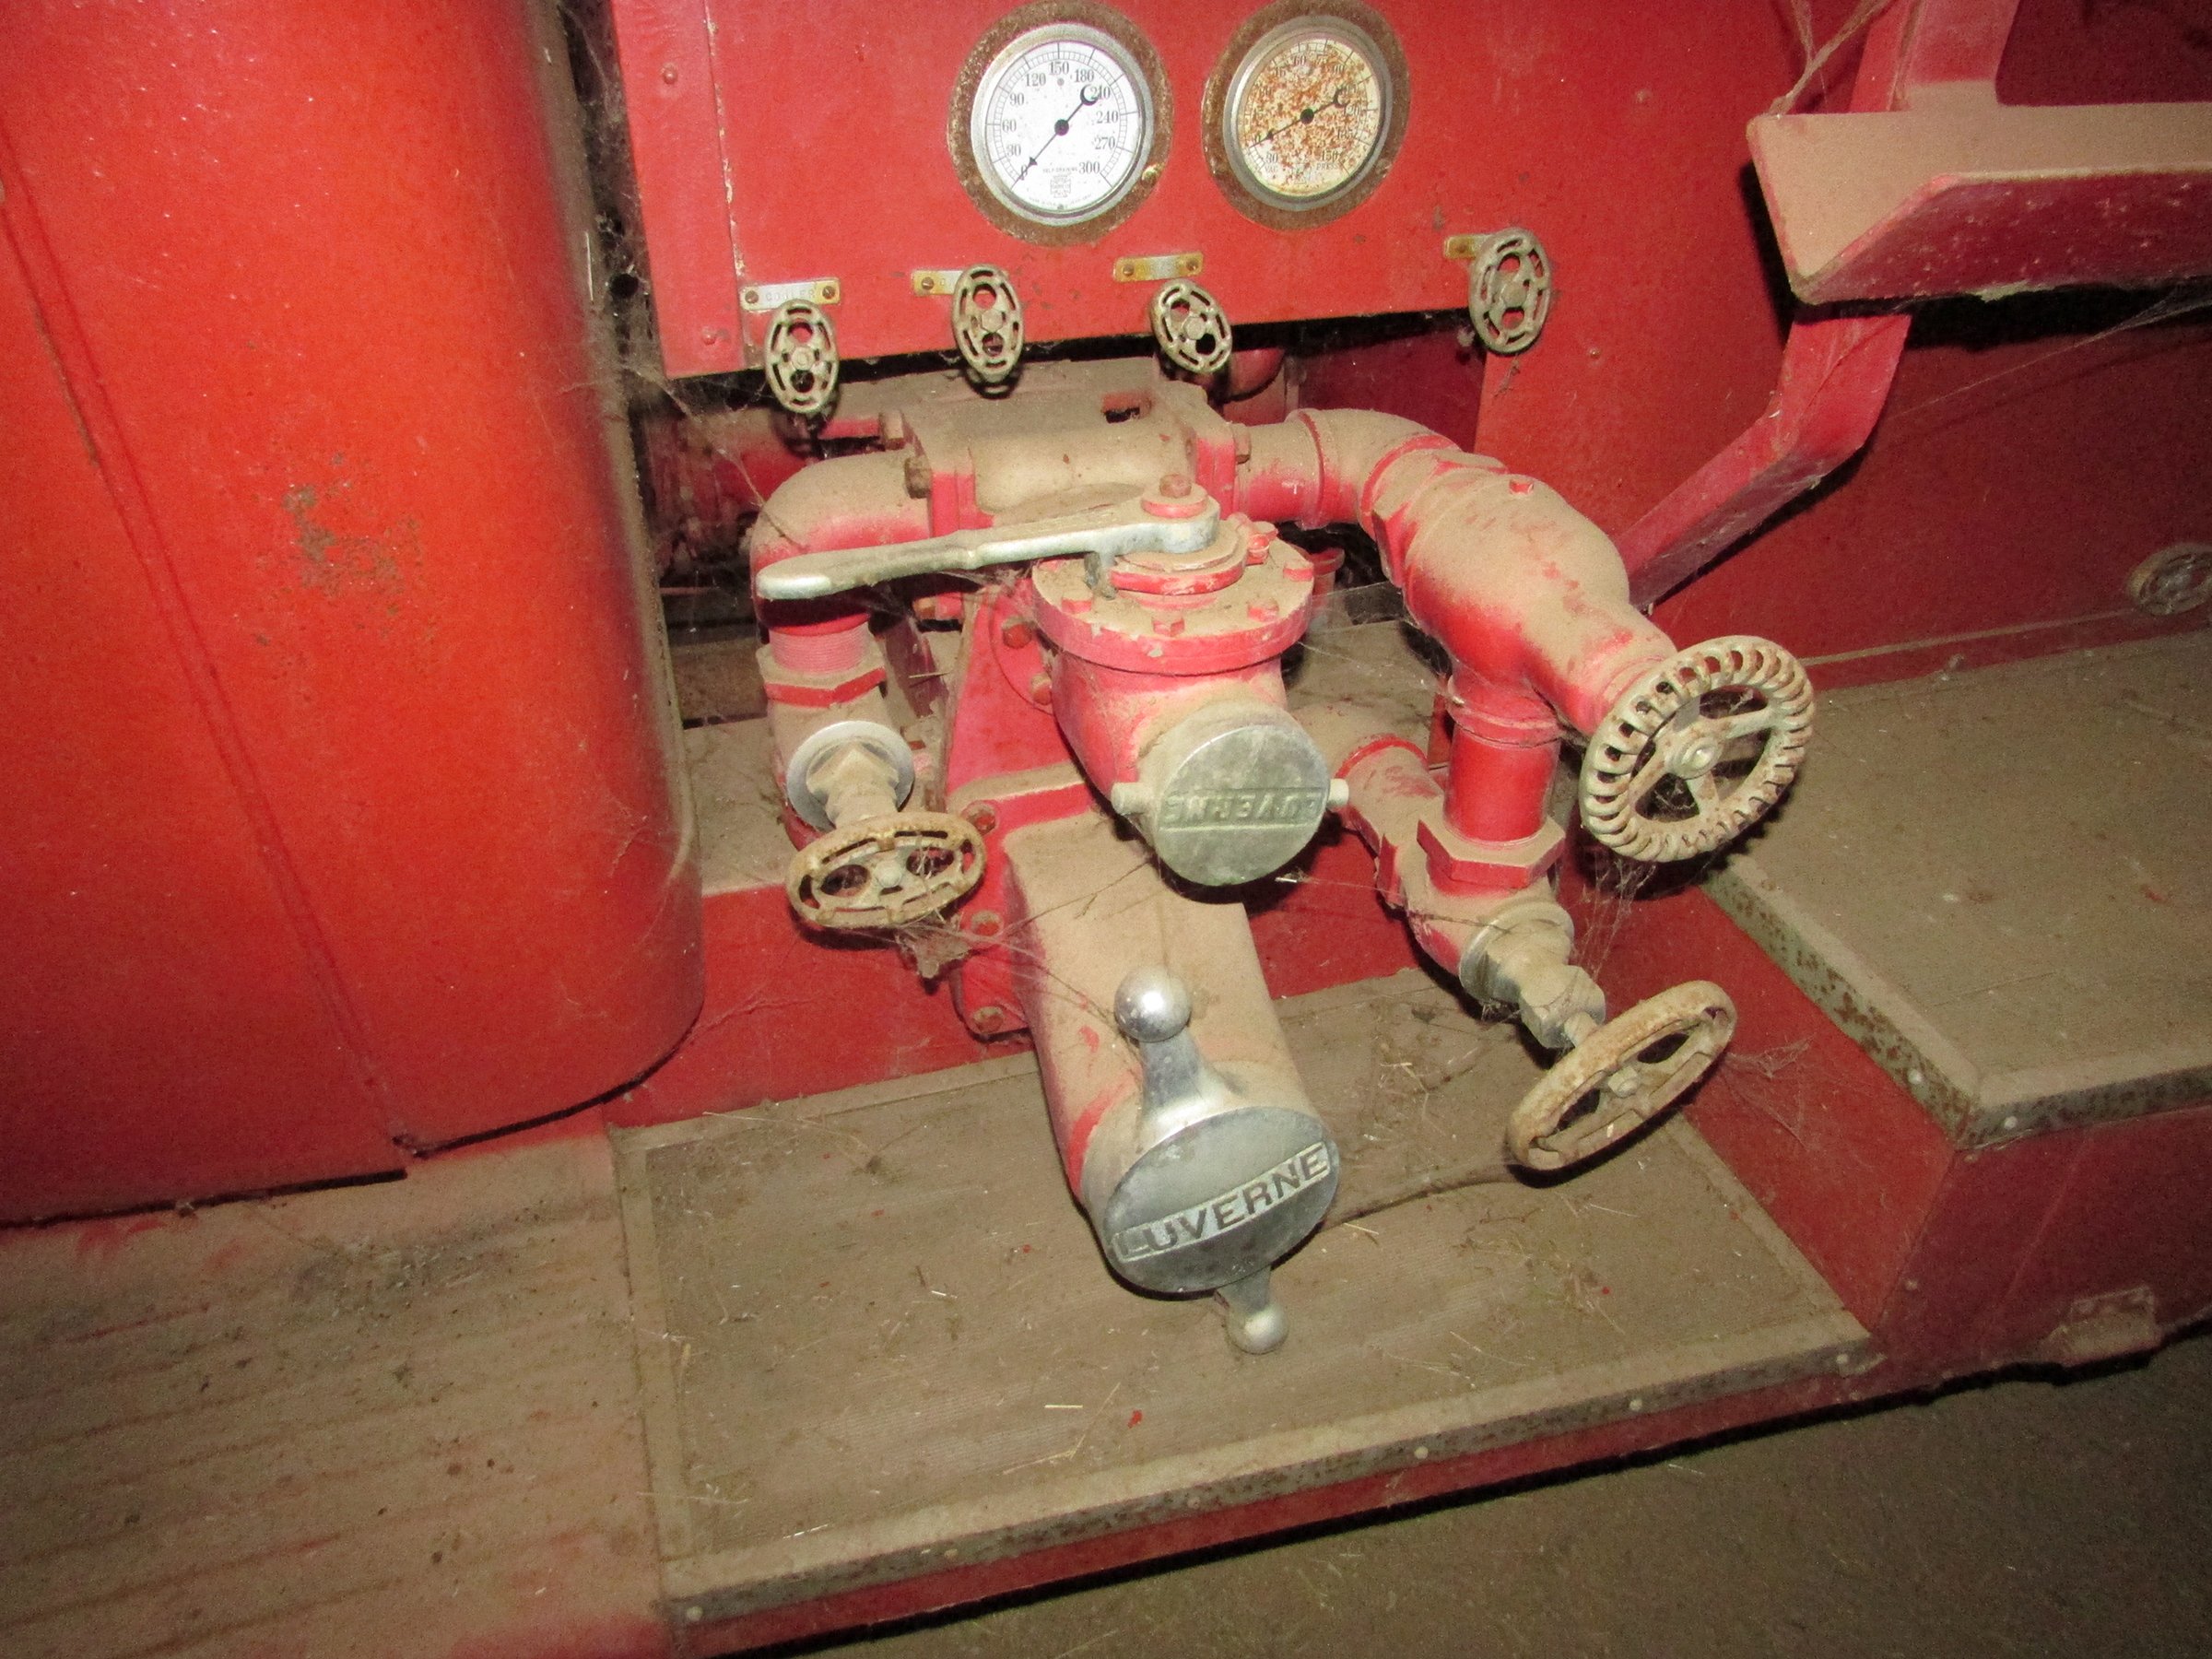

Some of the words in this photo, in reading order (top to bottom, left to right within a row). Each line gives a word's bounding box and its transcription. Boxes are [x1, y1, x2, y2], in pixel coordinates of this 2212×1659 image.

[1049, 61, 1069, 76] 150
[1075, 68, 1095, 83] 180
[1026, 73, 1046, 87] 120
[1009, 92, 1025, 107] 90
[1096, 110, 1118, 124] 240
[1002, 119, 1017, 133] 60
[1094, 136, 1115, 150] 270
[1006, 144, 1021, 157] 30
[1079, 160, 1100, 175] 300
[1116, 1143, 1328, 1256] LUVERNE
